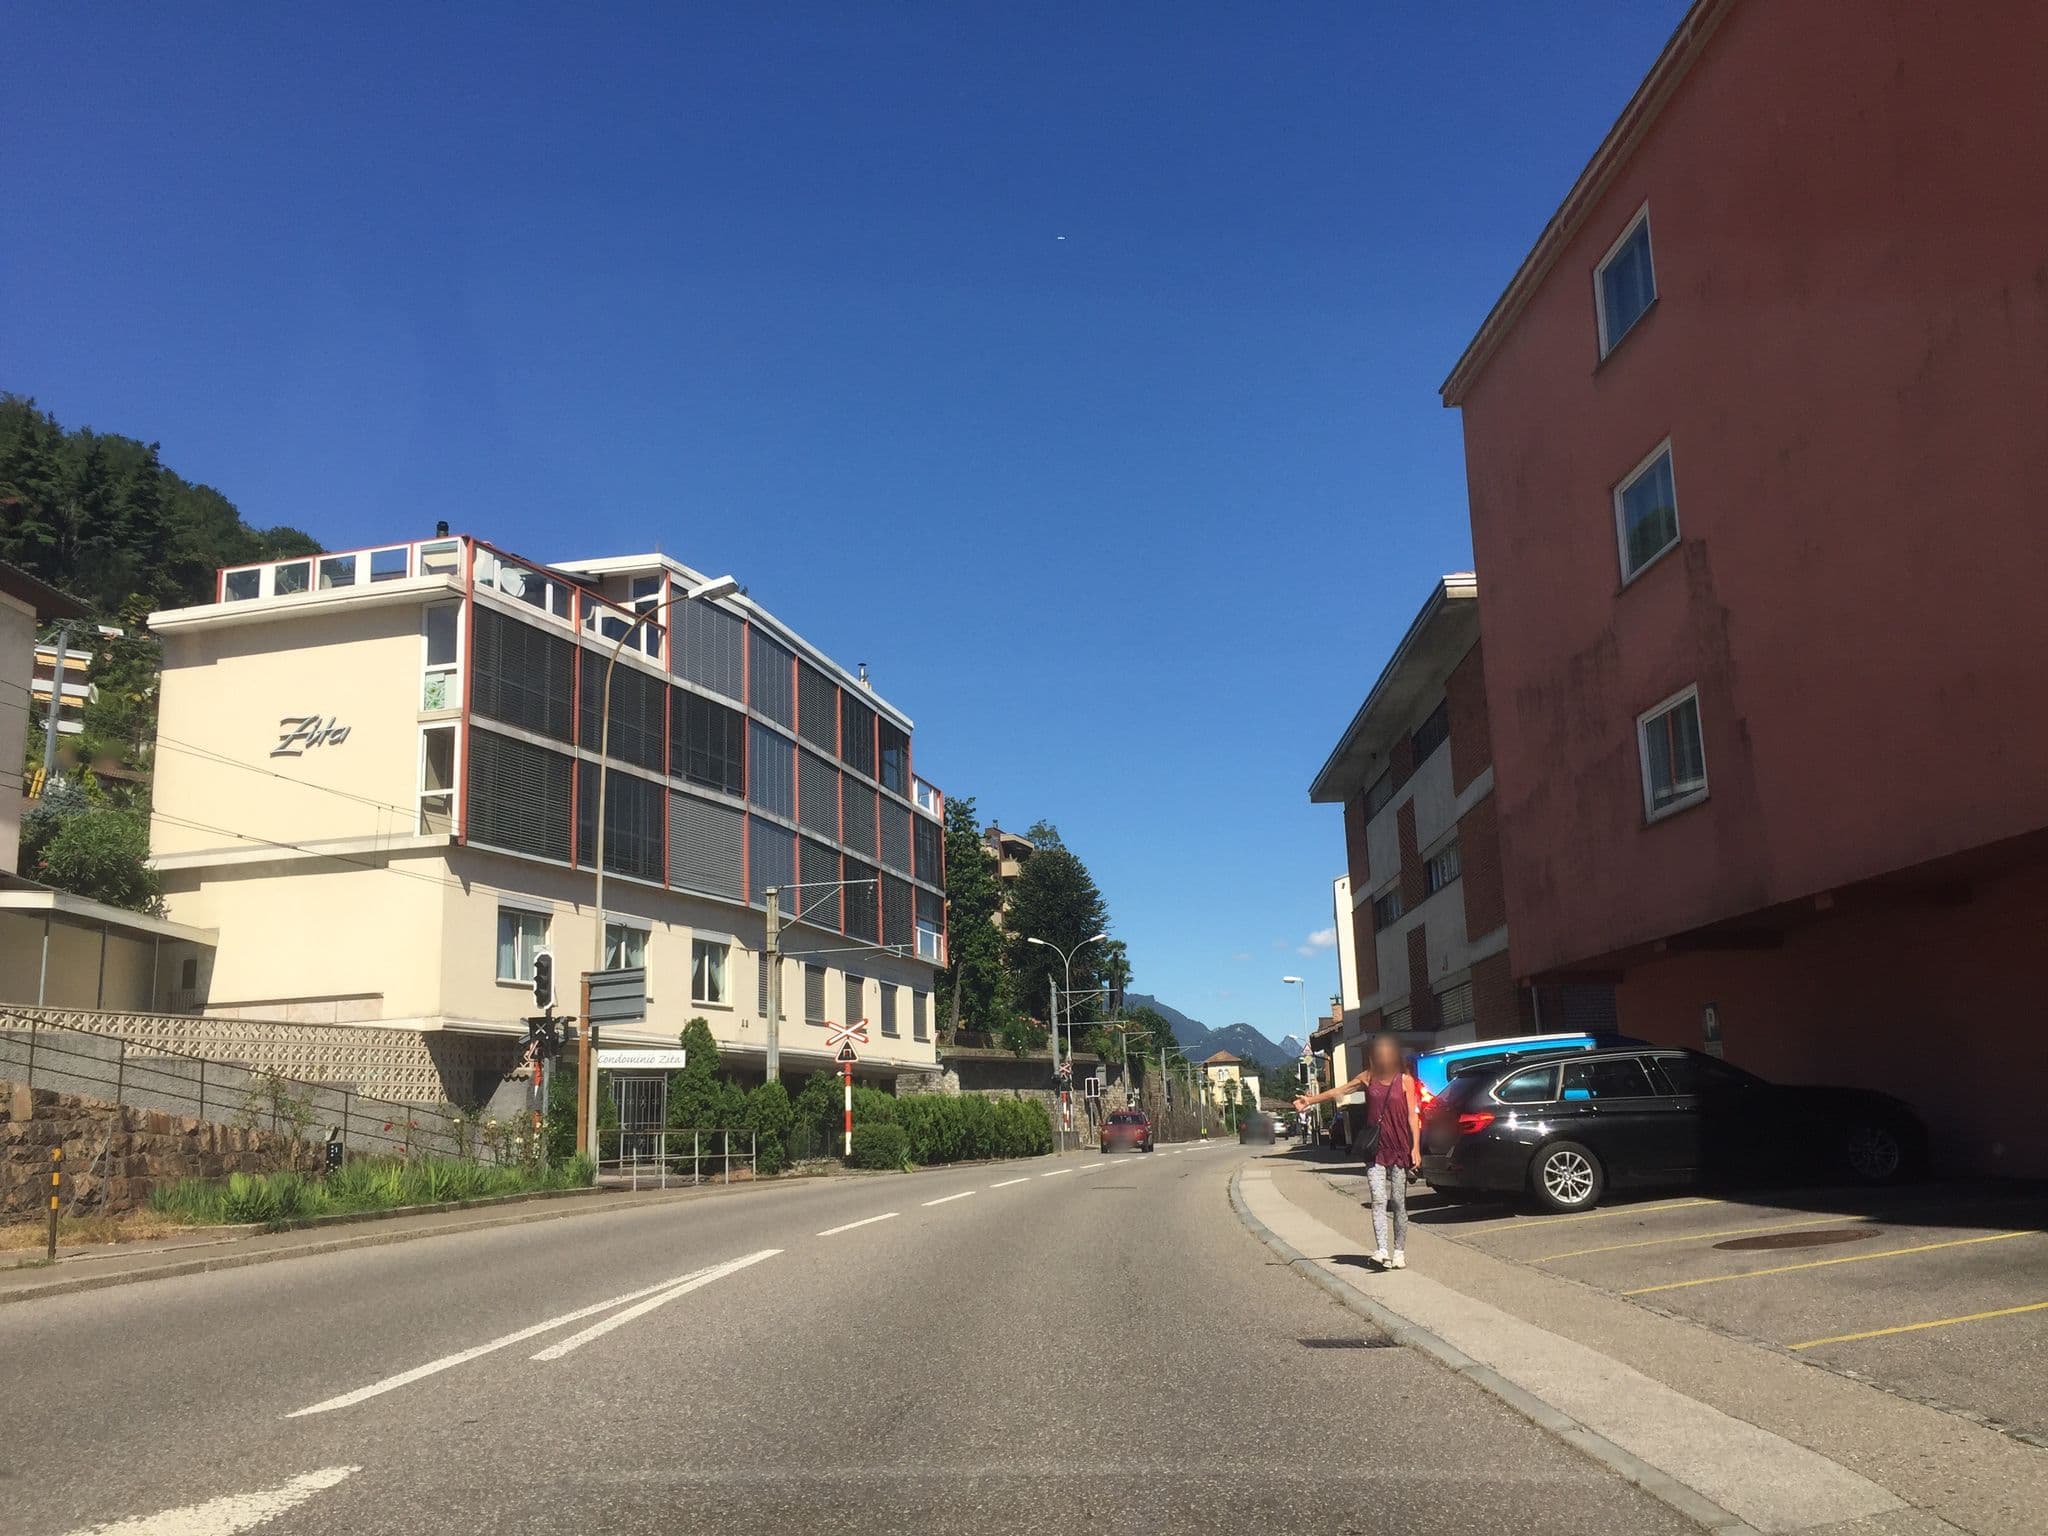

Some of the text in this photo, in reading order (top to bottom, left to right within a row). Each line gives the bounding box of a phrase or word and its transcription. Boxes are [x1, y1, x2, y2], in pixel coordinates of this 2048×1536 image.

[269, 713, 352, 759] Zita
[1705, 1007, 1716, 1039] P
[597, 1053, 683, 1065] Condominio Zita
